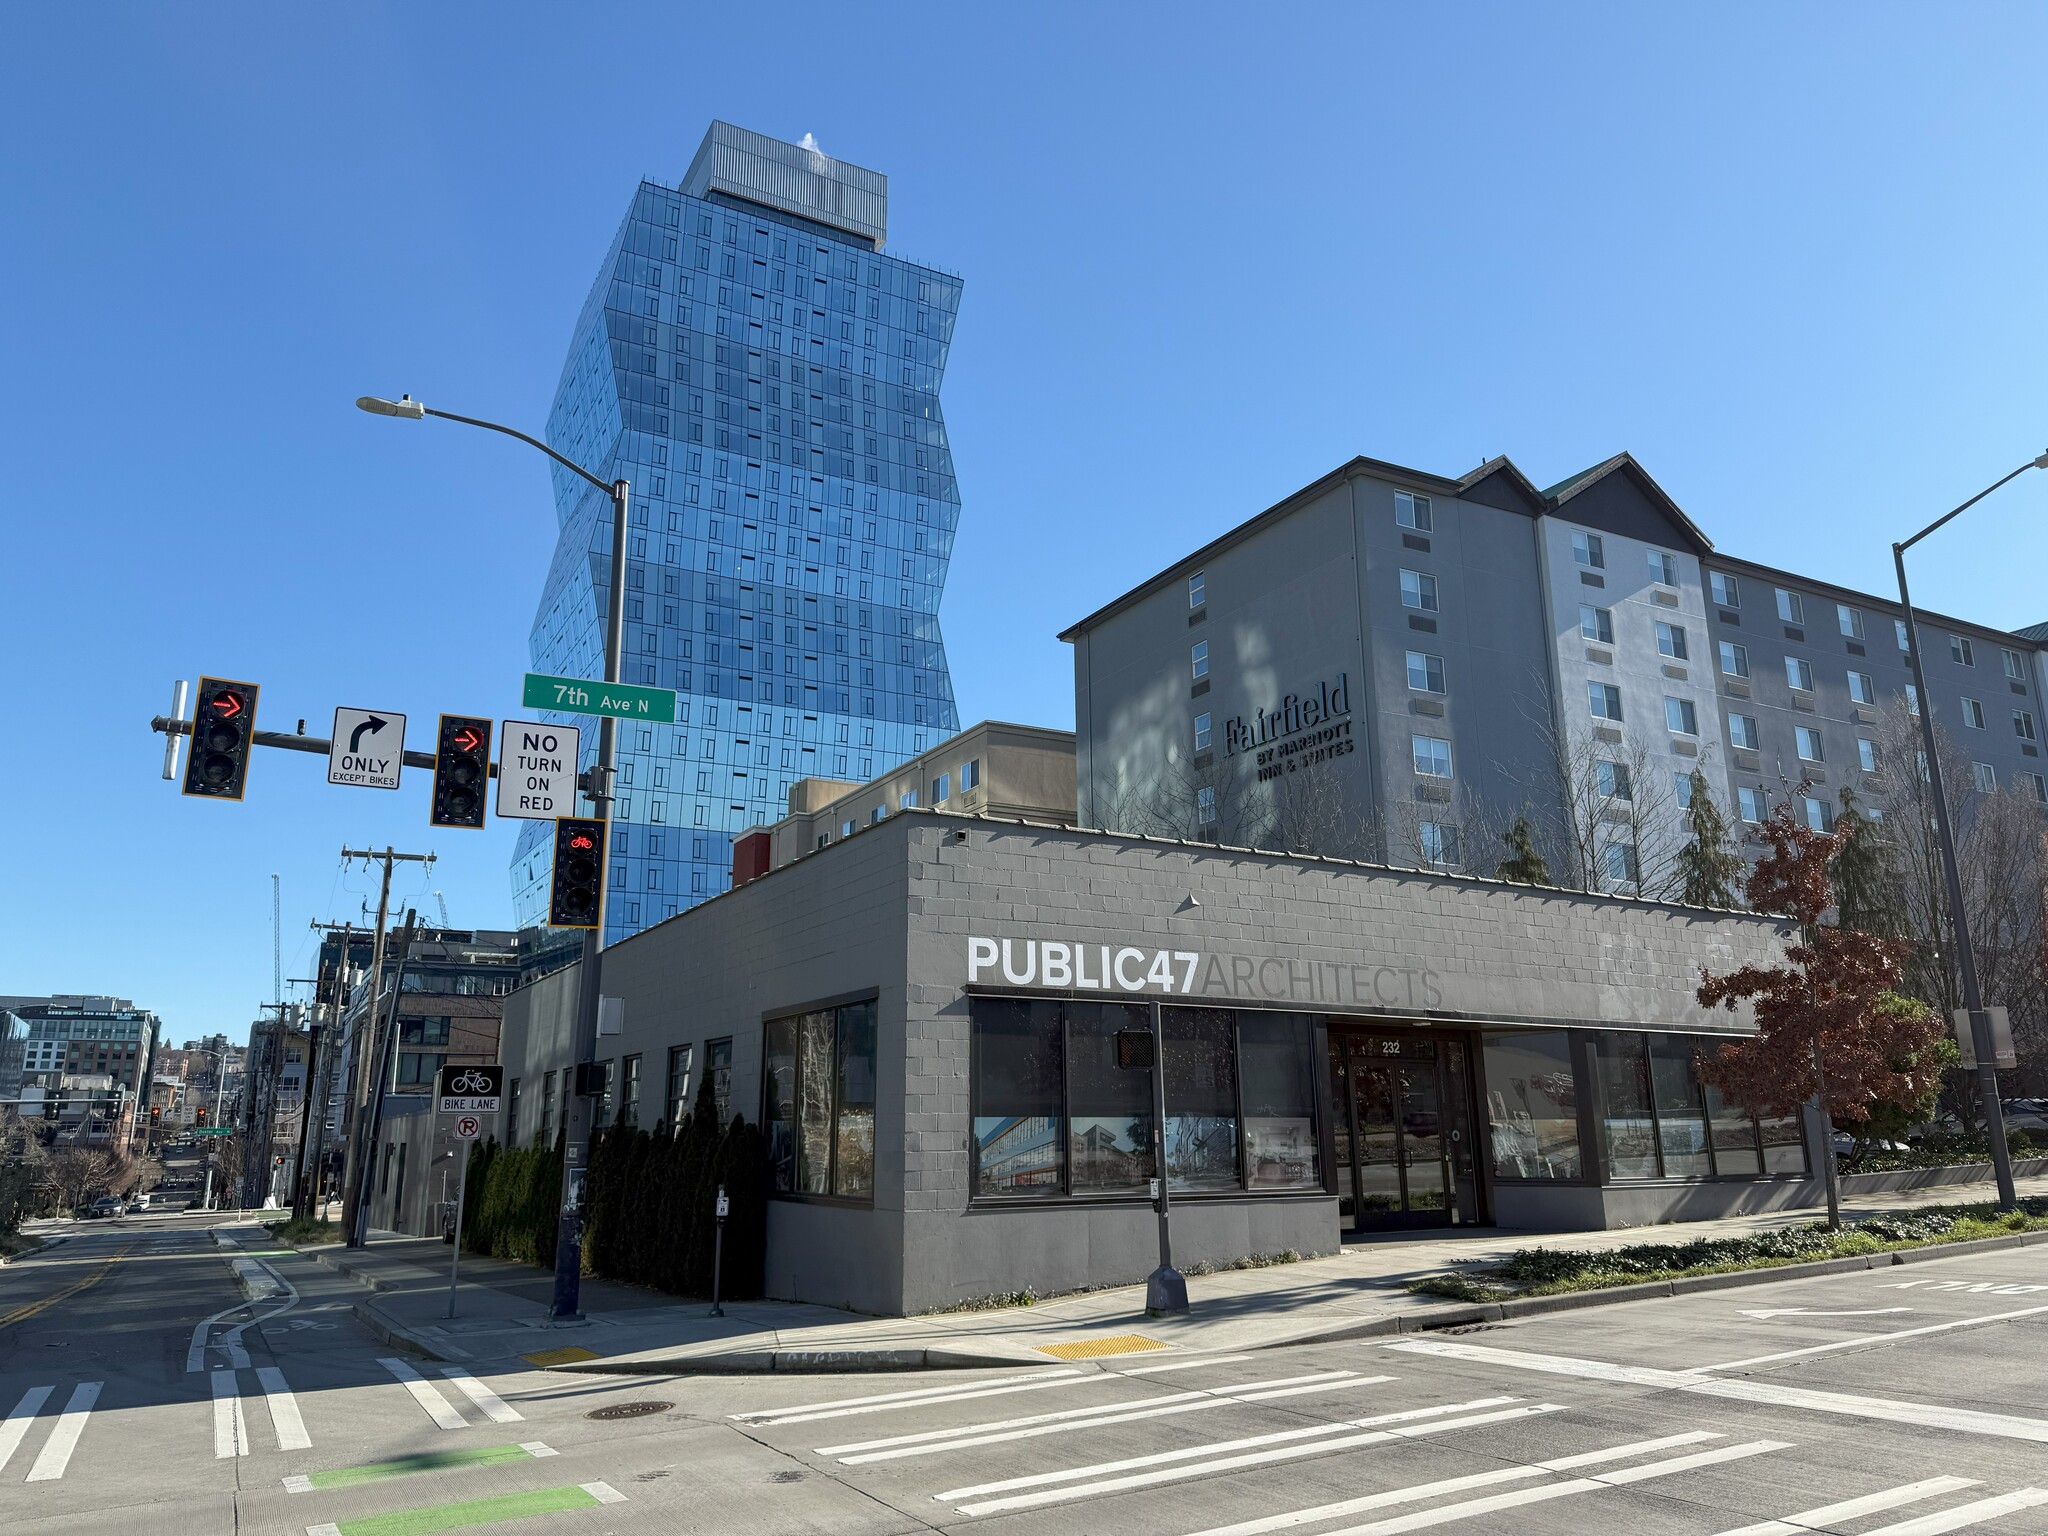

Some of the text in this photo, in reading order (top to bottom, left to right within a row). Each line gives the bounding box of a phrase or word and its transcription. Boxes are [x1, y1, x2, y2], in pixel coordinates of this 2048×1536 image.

[553, 684, 649, 713] 7th Ave N
[1221, 672, 1351, 758] Fairfield
[523, 733, 558, 753] NO
[1256, 721, 1352, 765] BY MARRIOTT
[342, 756, 389, 773] ONLY
[518, 756, 562, 773] TURN
[1257, 762, 1283, 782] INN
[333, 772, 395, 786] EXCEPT BIKES
[527, 776, 550, 791] ON
[520, 795, 553, 811] RED
[968, 937, 1442, 1010] PUBLIC47 ARCHITECTS
[1382, 1041, 1400, 1053] 232
[444, 1099, 496, 1110] BIKE LANE
